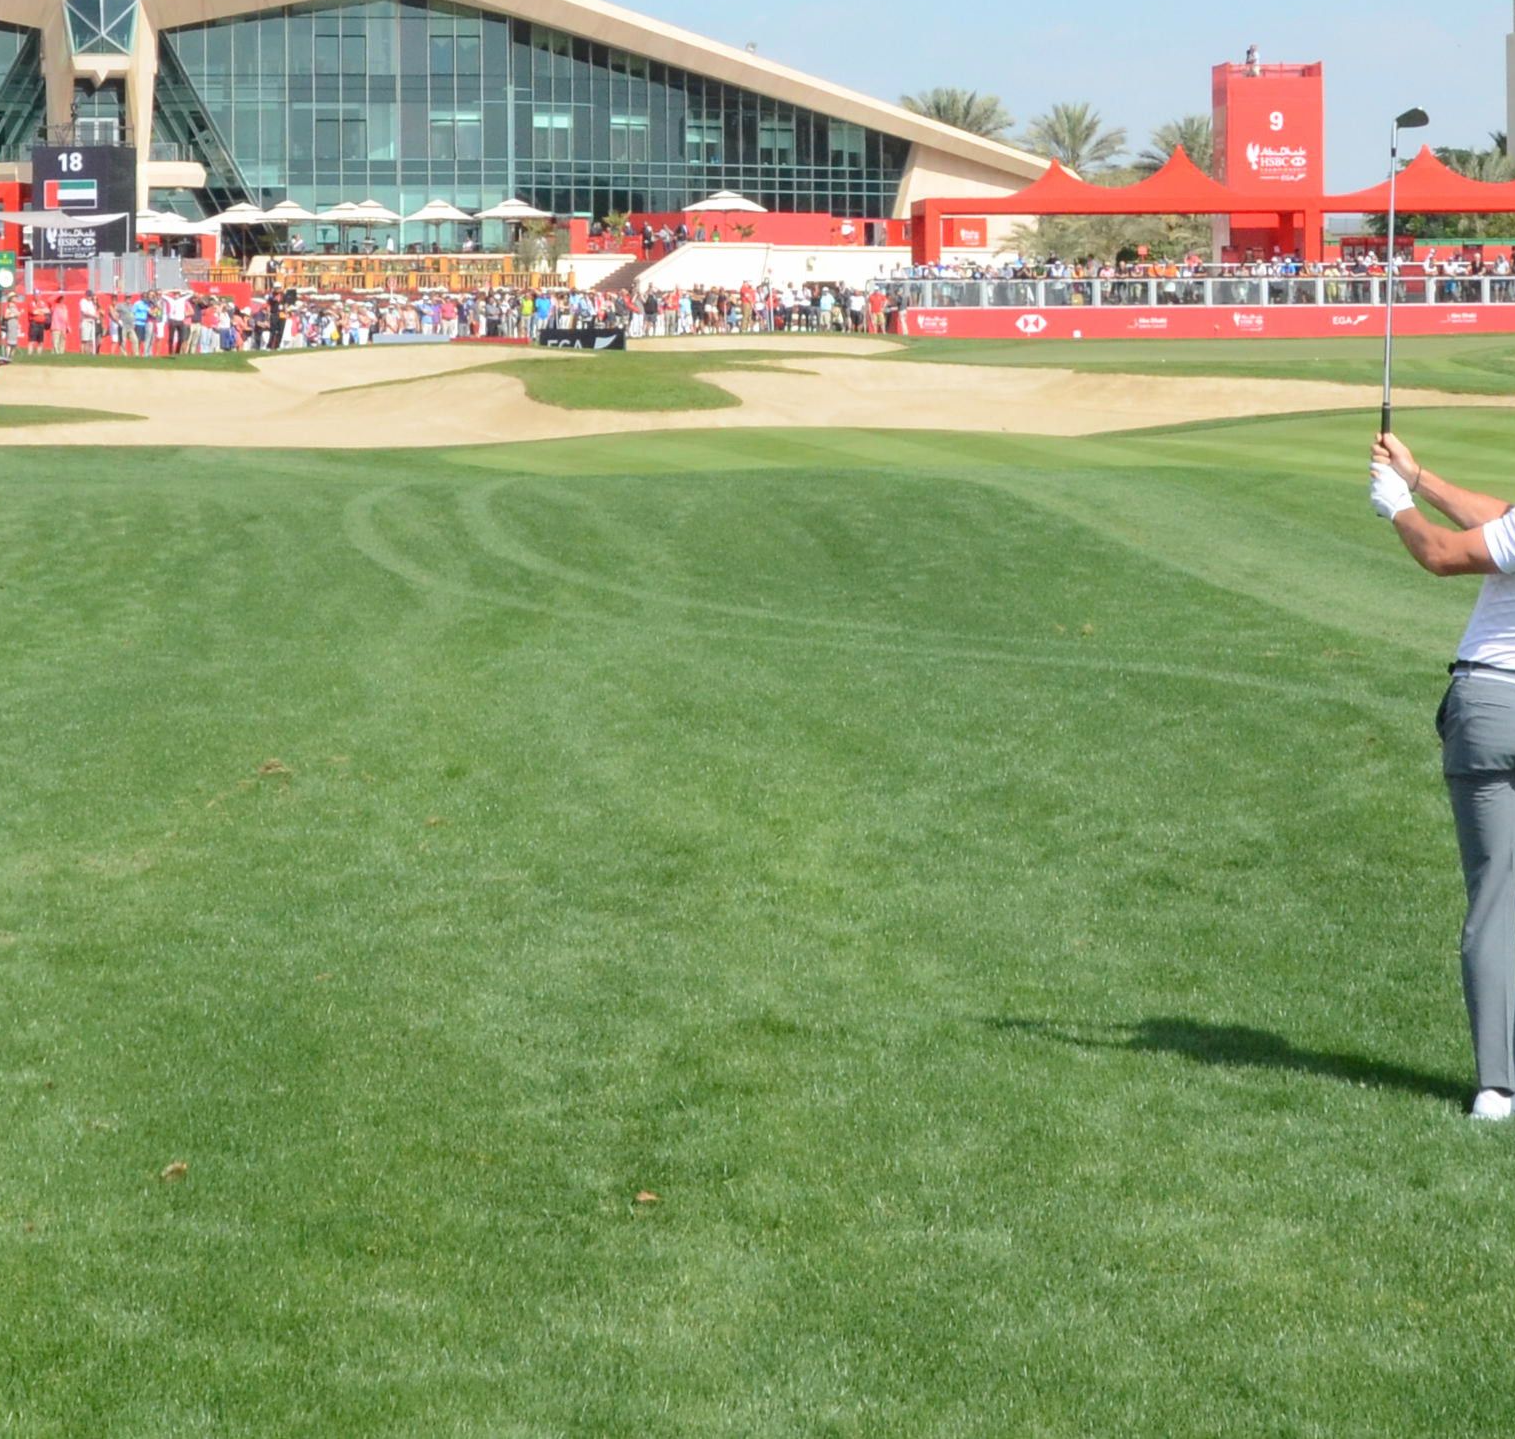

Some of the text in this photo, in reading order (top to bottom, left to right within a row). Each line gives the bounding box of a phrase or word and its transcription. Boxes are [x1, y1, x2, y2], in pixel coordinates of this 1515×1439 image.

[1269, 111, 1284, 131] 9
[57, 152, 83, 172] 18
[1260, 157, 1290, 167] HSBC
[57, 238, 82, 246] HSBC
[1332, 315, 1352, 325] EGA
